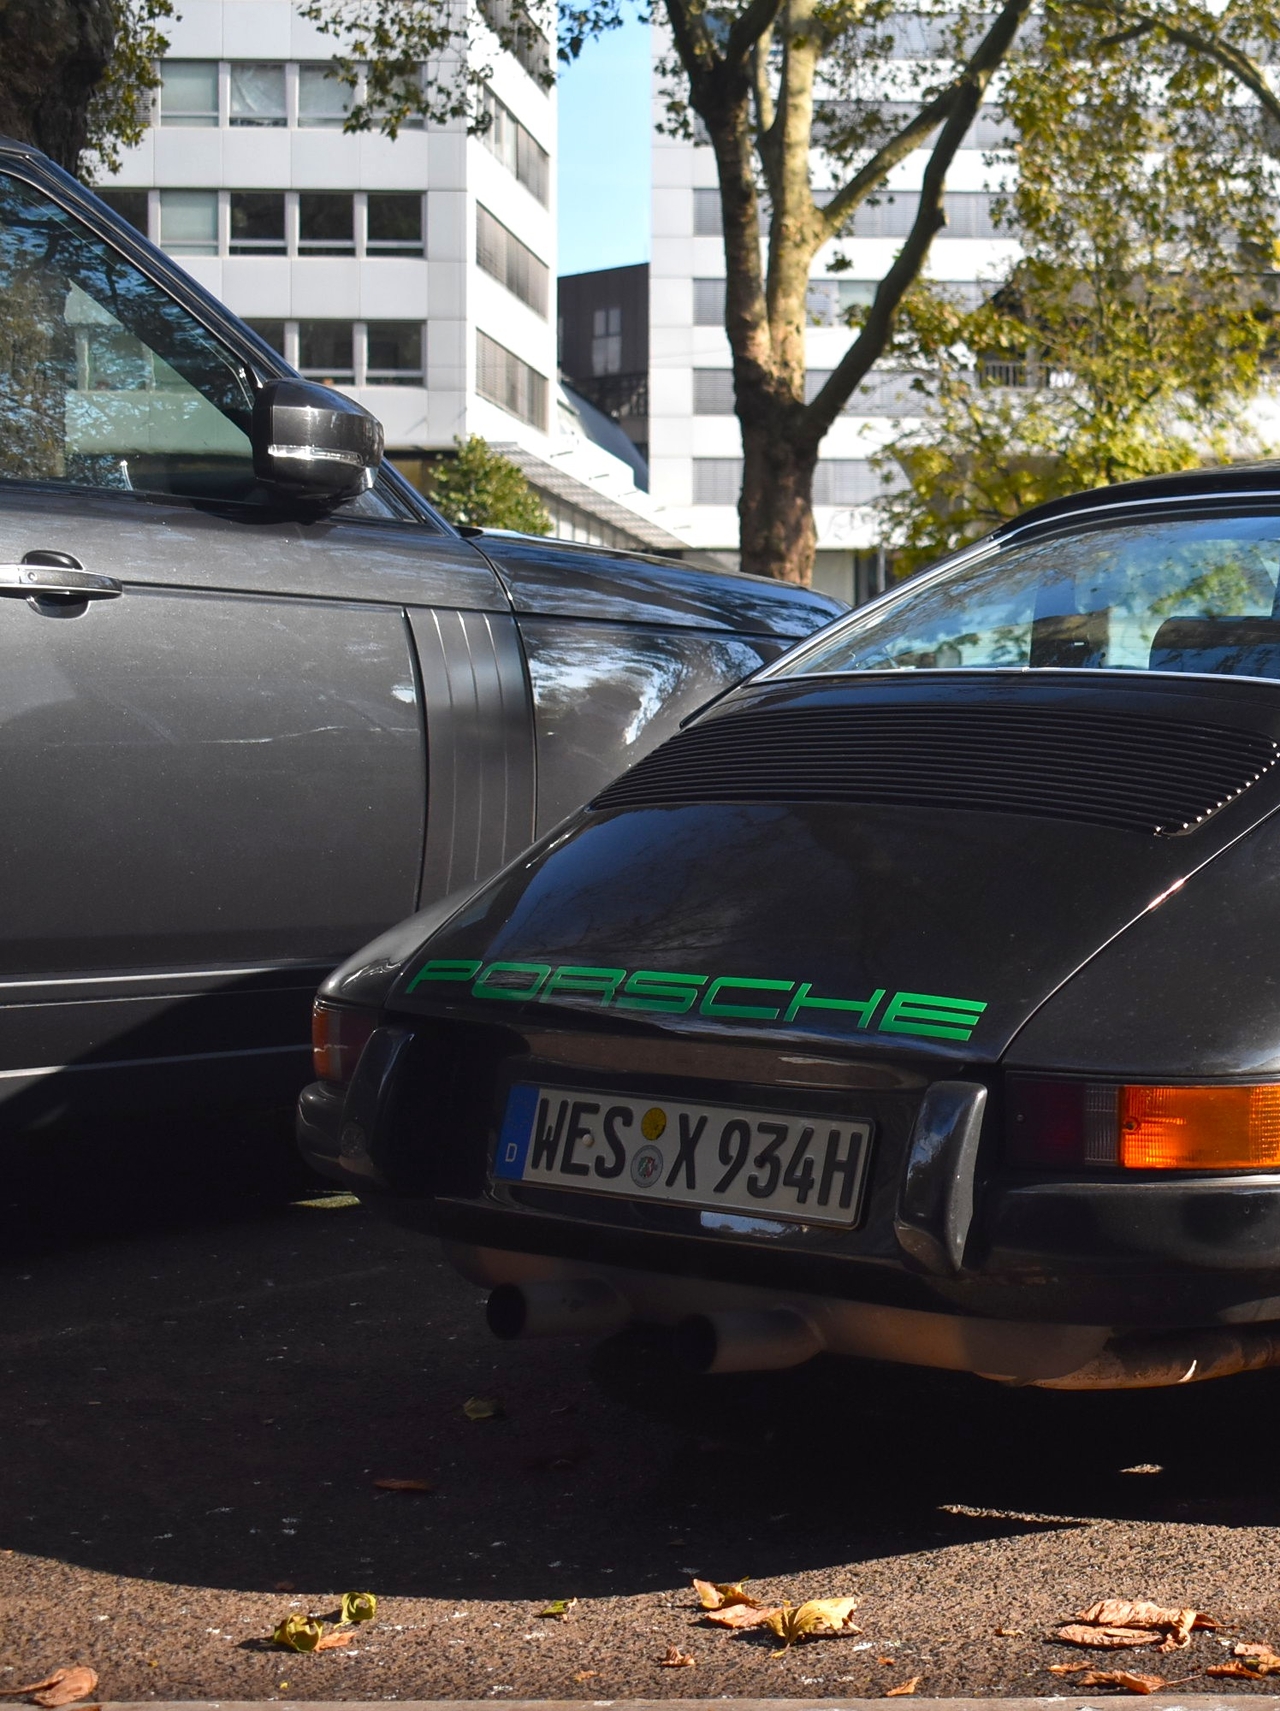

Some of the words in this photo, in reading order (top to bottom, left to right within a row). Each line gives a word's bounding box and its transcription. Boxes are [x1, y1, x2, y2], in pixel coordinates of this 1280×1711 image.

[405, 960, 987, 1041] PORSCHE
[505, 1143, 517, 1163] D
[532, 1098, 633, 1179] WES
[665, 1113, 708, 1190] X
[713, 1118, 862, 1208] 934H
